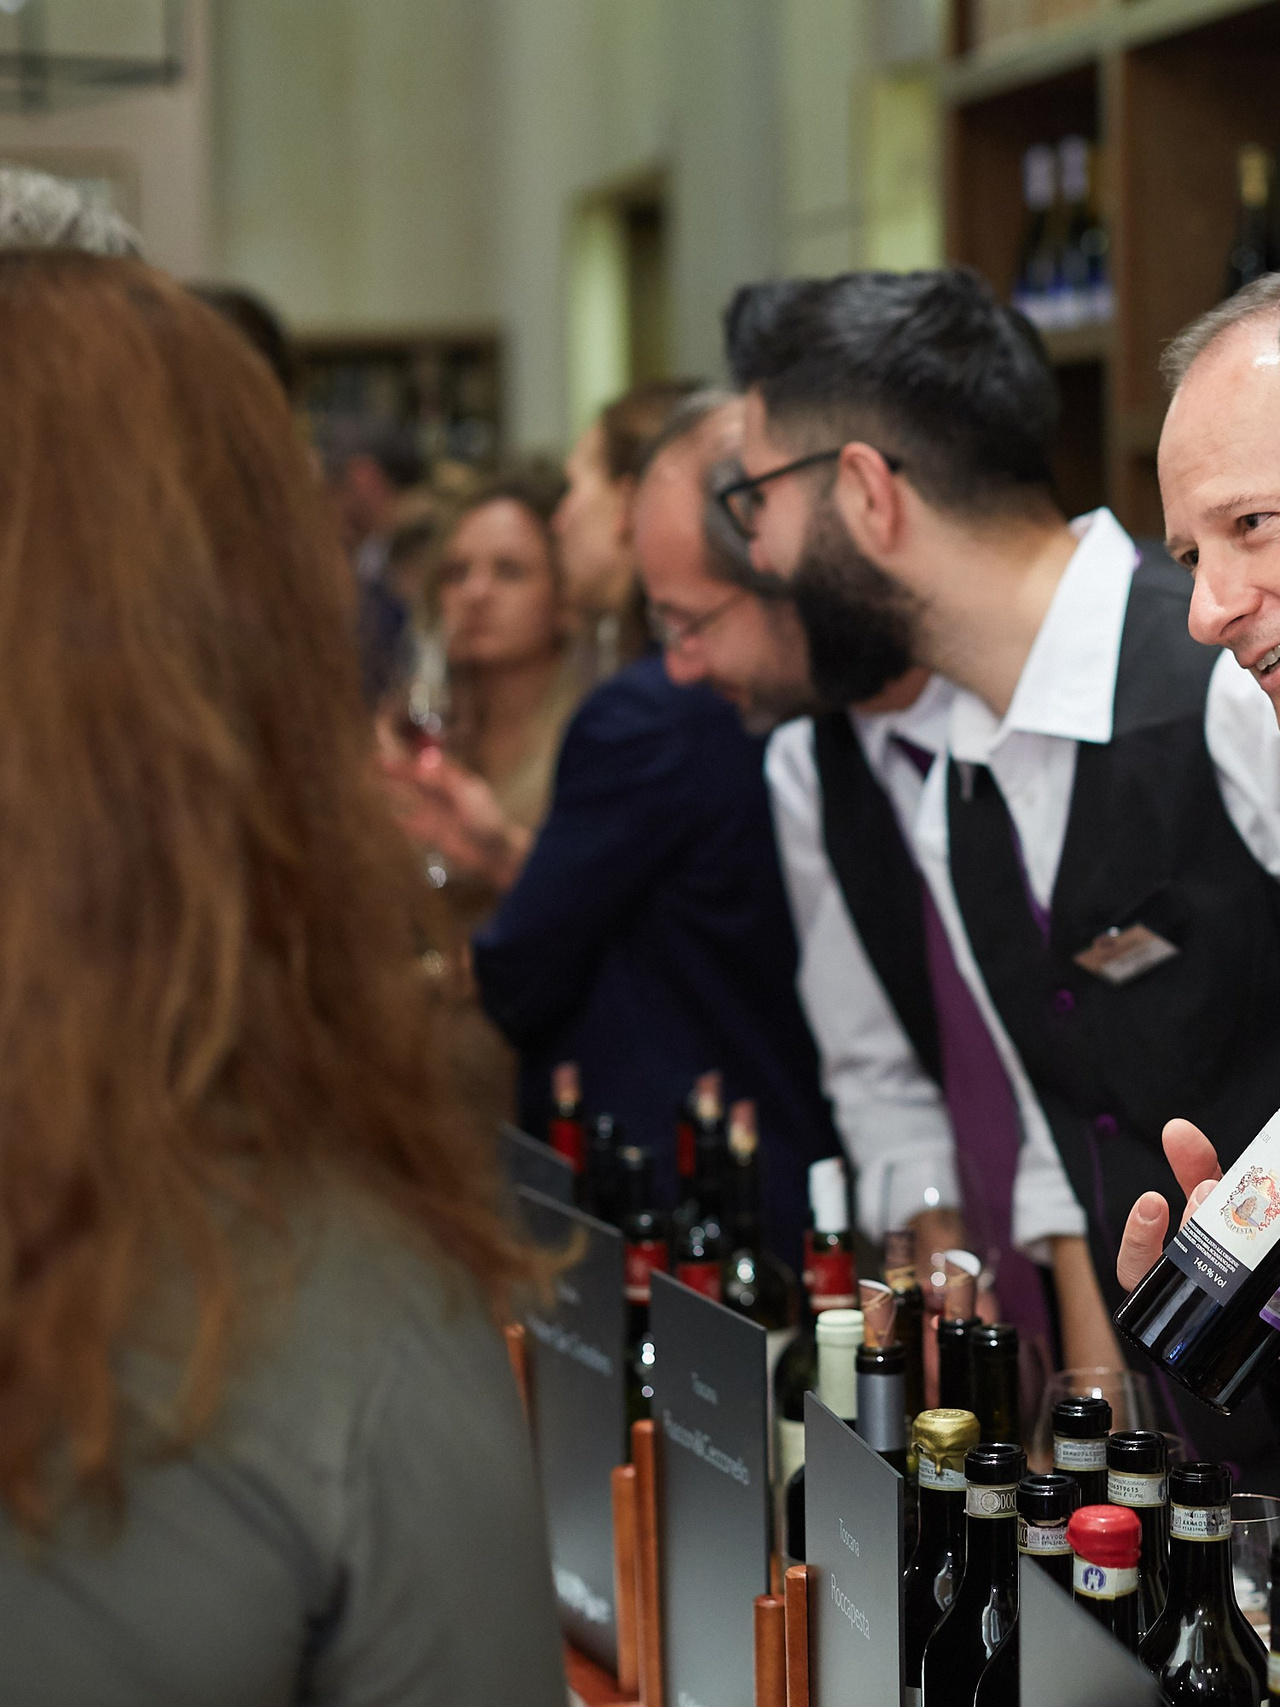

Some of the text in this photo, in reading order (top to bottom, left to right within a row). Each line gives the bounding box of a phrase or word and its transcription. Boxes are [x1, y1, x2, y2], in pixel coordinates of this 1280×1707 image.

[1193, 1257, 1228, 1288] 14,0 % Vol
[838, 1517, 860, 1557] Toscana
[830, 1573, 871, 1640] Roccapesta
